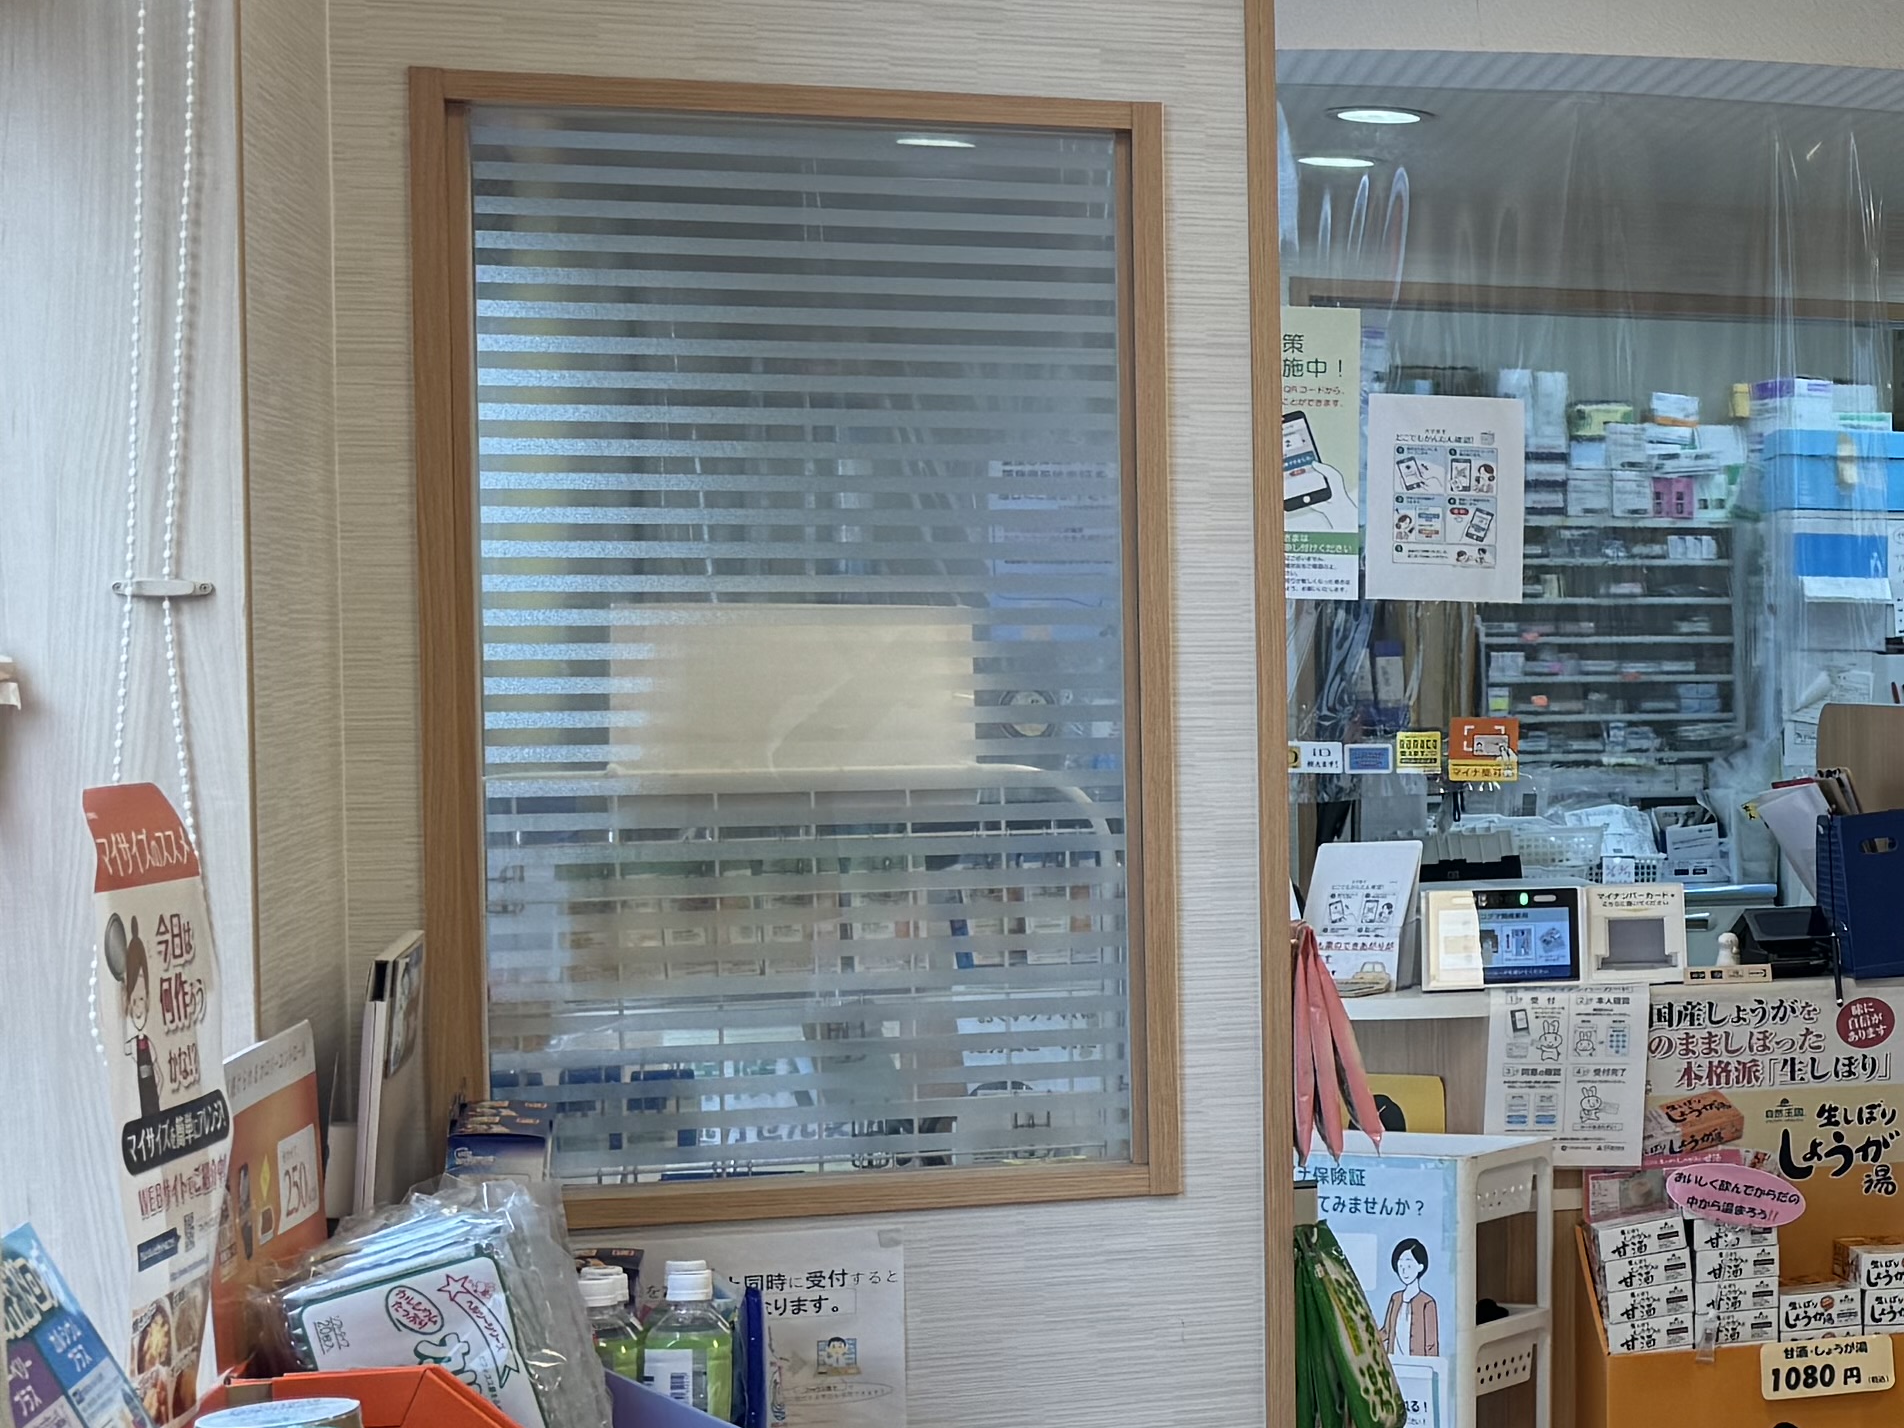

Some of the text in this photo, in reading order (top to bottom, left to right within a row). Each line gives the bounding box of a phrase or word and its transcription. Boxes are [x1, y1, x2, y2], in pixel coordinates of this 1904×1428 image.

[96, 825, 193, 877] マイサイズのススメ
[155, 912, 193, 962] 今日は
[1649, 999, 1819, 1029] 国産しょうがを
[1649, 1028, 1827, 1059] のまましぼった
[1847, 1026, 1887, 1041] あります
[1675, 1052, 1892, 1089] 本格派「生しぼり」
[1816, 1102, 1898, 1128] 生しぼり
[1777, 1130, 1901, 1181] しょうが
[1674, 1172, 1800, 1207] おいしく飲んでからだの
[1863, 1167, 1897, 1195] 湯
[1318, 1195, 1425, 1217] てみませんか?
[1686, 1196, 1779, 1222] 中から温まろう!!
[1783, 1341, 1868, 1359] 甘酒・しょうが湯
[1770, 1364, 1836, 1392] 1080
[1843, 1367, 1862, 1386] 円
